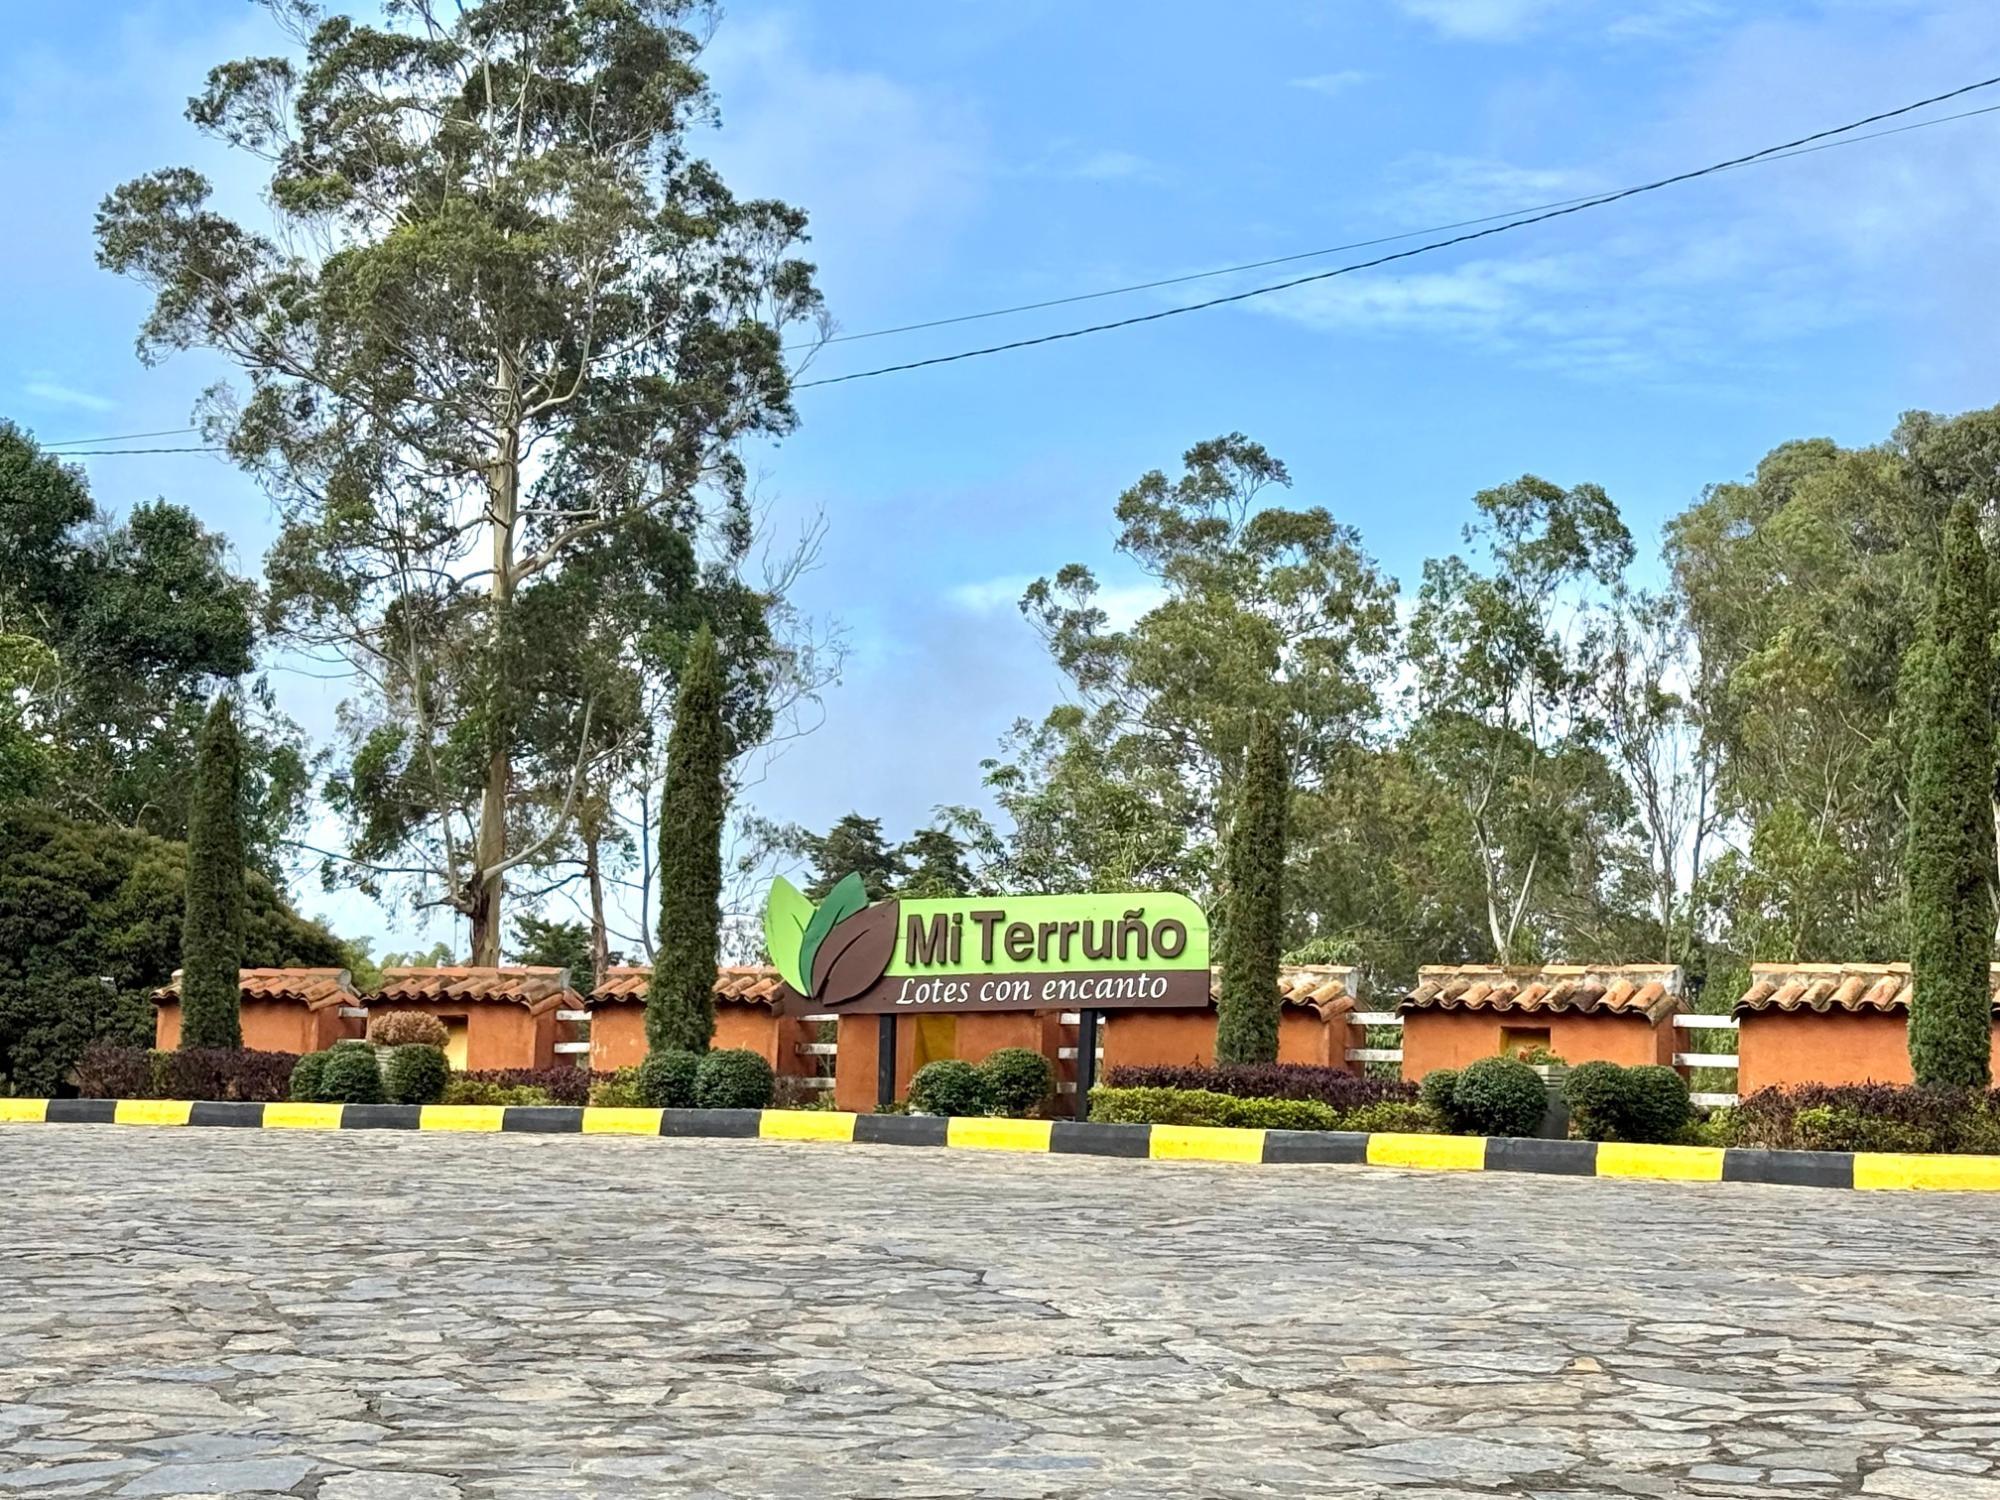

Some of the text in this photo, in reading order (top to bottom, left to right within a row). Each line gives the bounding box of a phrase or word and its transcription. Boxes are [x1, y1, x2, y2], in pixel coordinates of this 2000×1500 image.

[905, 908, 1187, 965] Mi Terruño
[896, 973, 1168, 1005] Lotes con encanto
